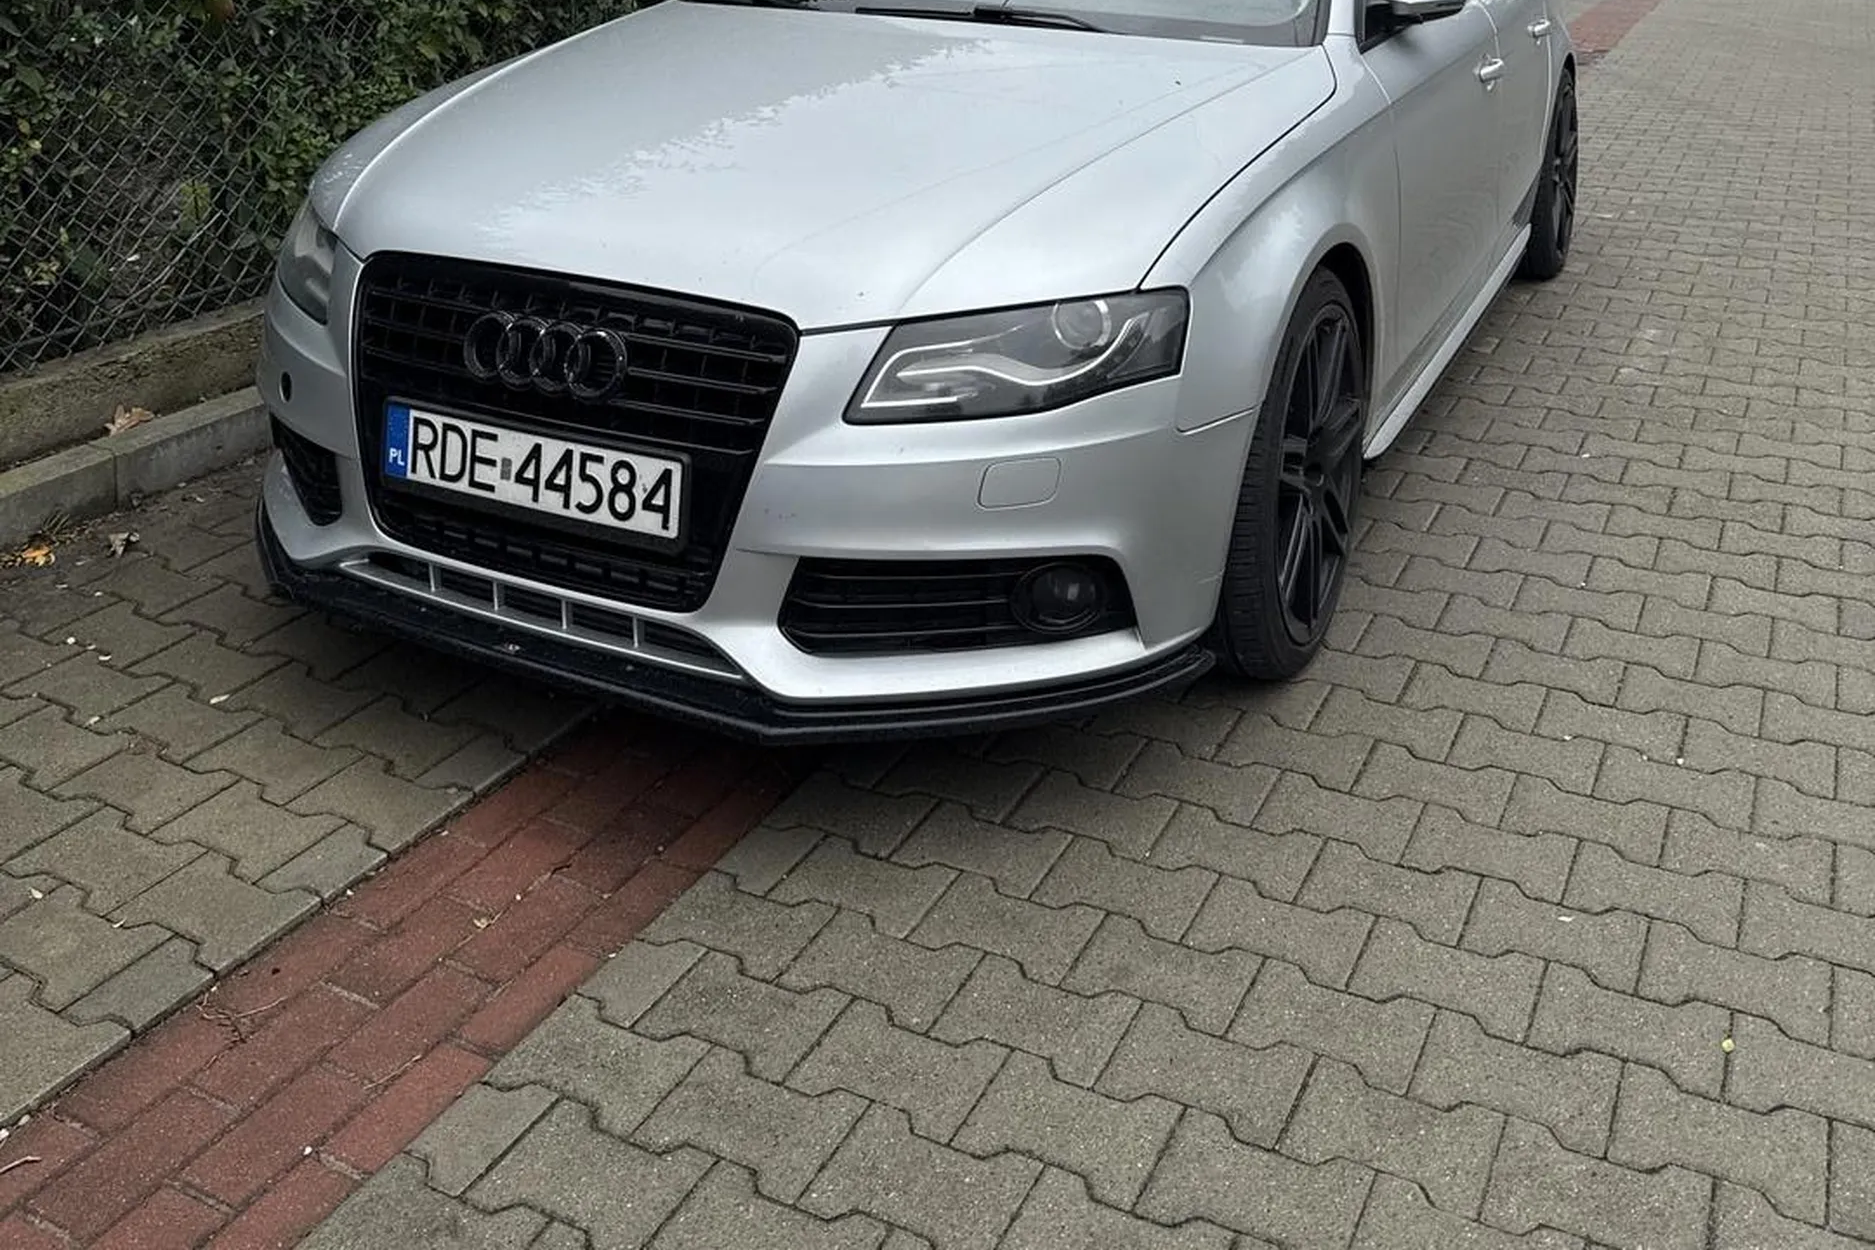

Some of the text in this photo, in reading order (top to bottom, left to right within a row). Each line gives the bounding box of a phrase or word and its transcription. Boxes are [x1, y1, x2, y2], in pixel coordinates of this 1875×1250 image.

[388, 447, 405, 466] PL
[410, 416, 673, 531] RDE 44584
